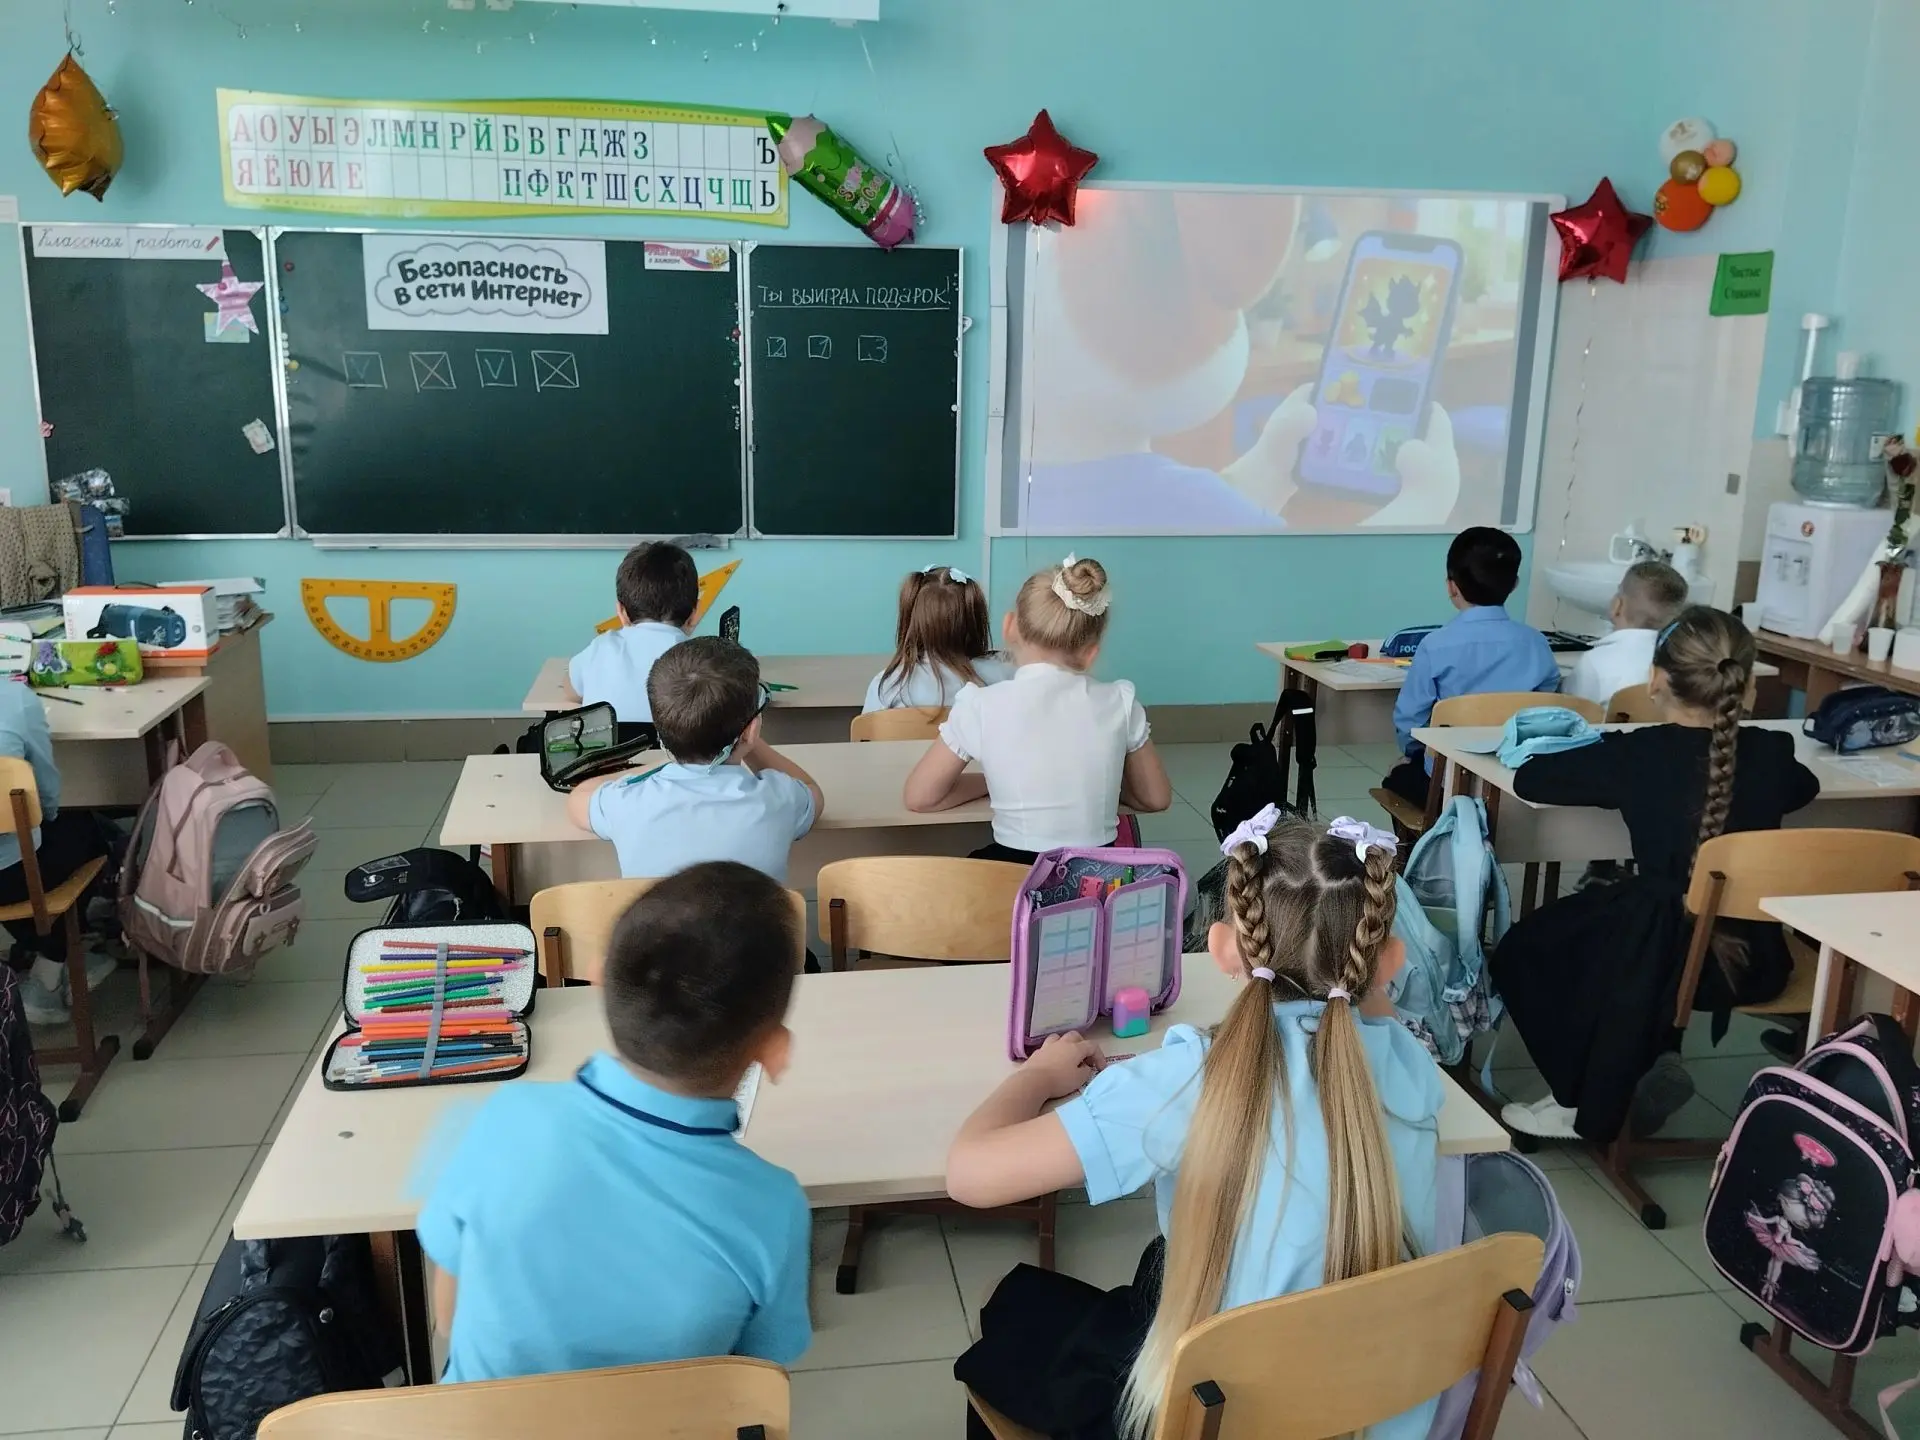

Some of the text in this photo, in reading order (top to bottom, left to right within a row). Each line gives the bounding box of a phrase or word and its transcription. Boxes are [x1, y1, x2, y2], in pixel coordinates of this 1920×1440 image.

[233, 113, 775, 164] А О У Ы Э Л М Н Р Й Б В Г Д Ж З Ъ
[238, 154, 775, 210] Я Ё Ю И Е П Ф К Т Ш С Х Ц Ч Щ Ь
[38, 228, 203, 257] Классная работа
[397, 259, 568, 285] Безопасность
[415, 282, 466, 301] сети
[471, 280, 582, 308] Интернет
[792, 288, 859, 305] ВЫИГРАЛ
